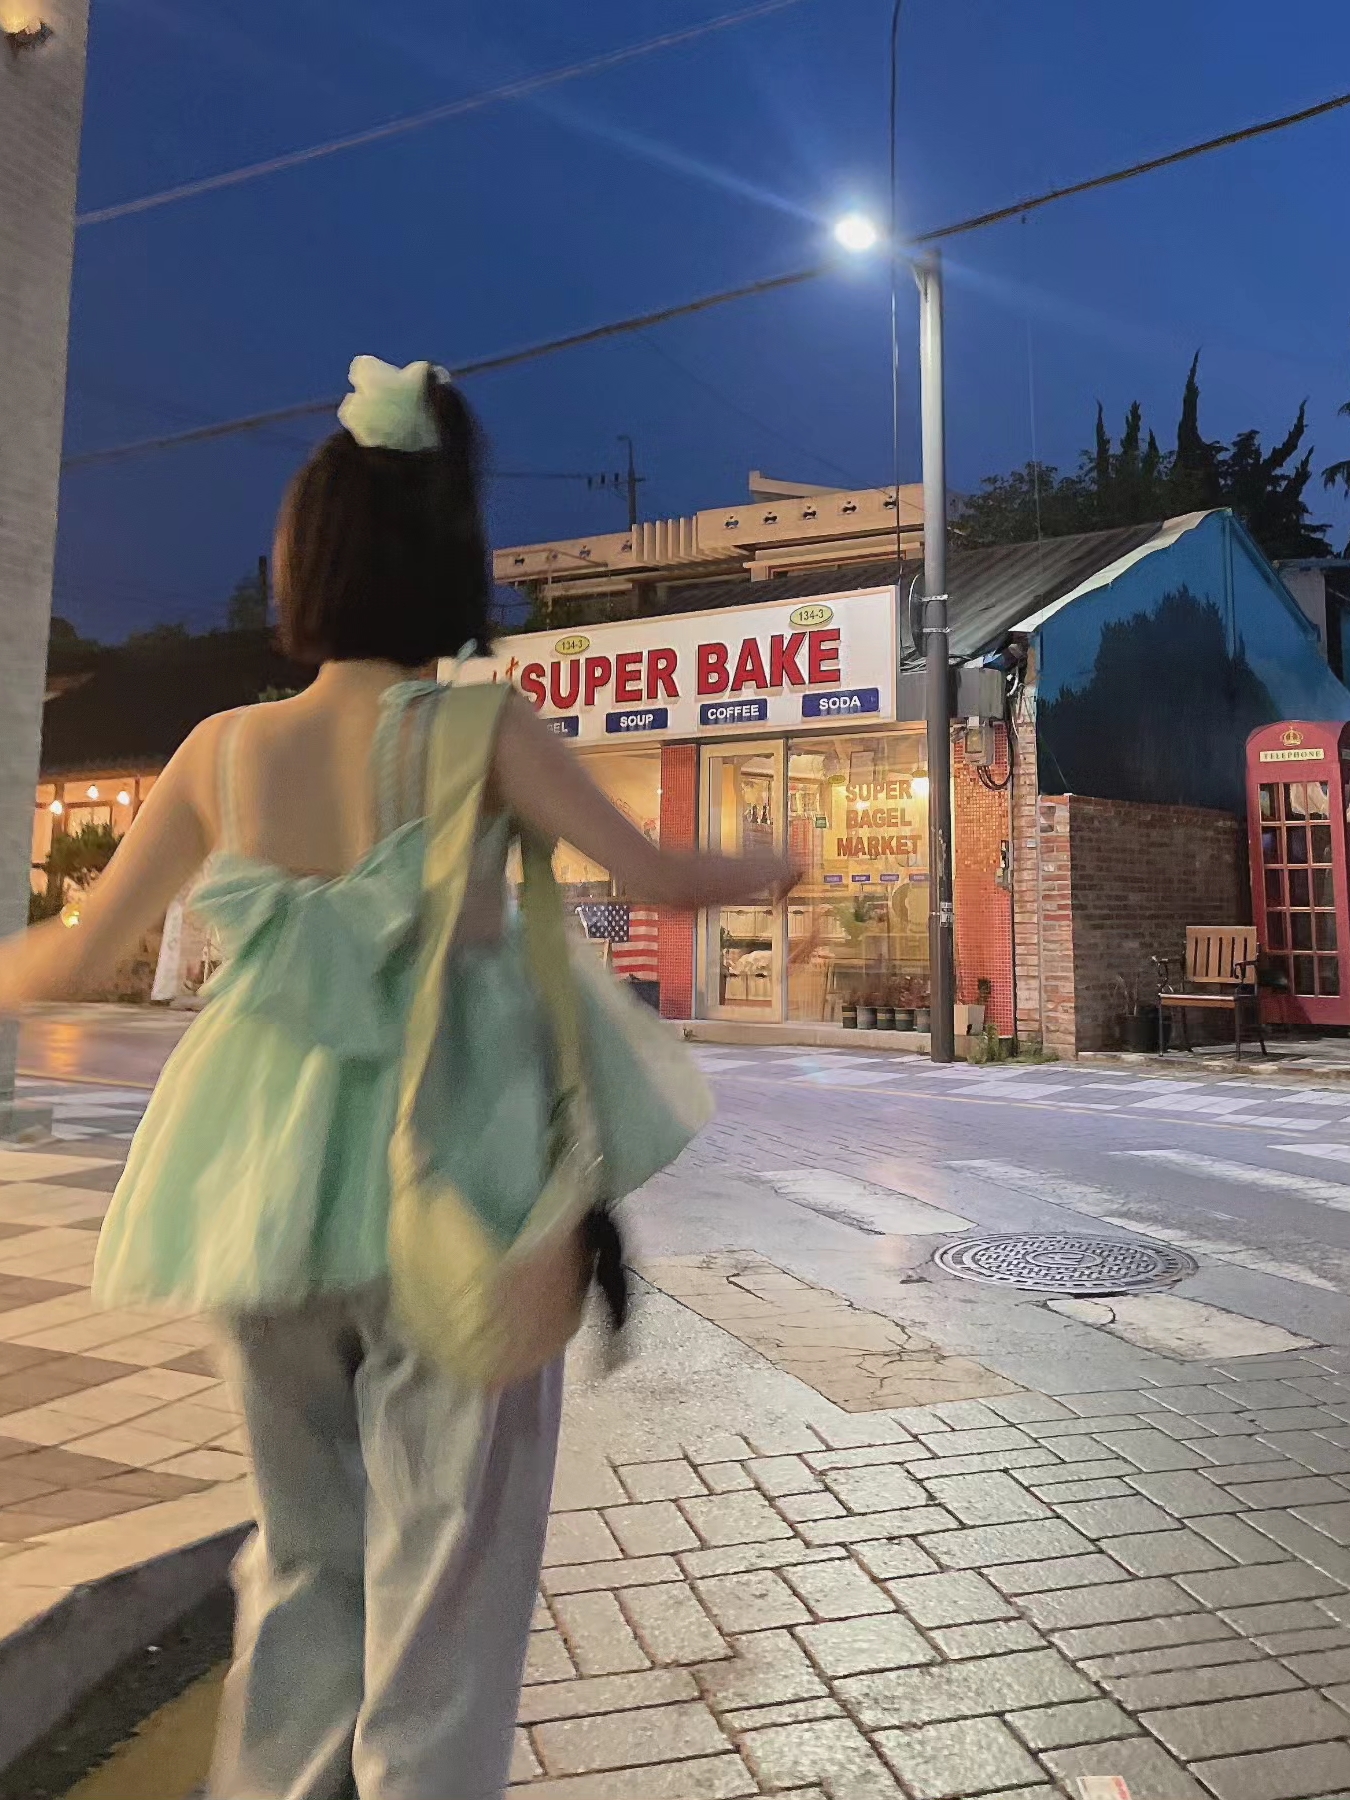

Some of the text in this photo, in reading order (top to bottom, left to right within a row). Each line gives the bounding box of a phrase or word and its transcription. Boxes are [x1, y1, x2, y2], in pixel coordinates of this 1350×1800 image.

[798, 608, 824, 622] 134-3
[561, 639, 583, 652] 134-3
[521, 647, 680, 713] SUPER
[697, 628, 841, 696] BAKE
[819, 695, 861, 710] SODA
[707, 704, 760, 720] COFFEE
[619, 713, 654, 728] SOUP
[1263, 750, 1321, 760] TELEPHONE
[846, 780, 912, 802] SUPER
[846, 808, 912, 829] BAGEL
[837, 834, 922, 858] MARKET
